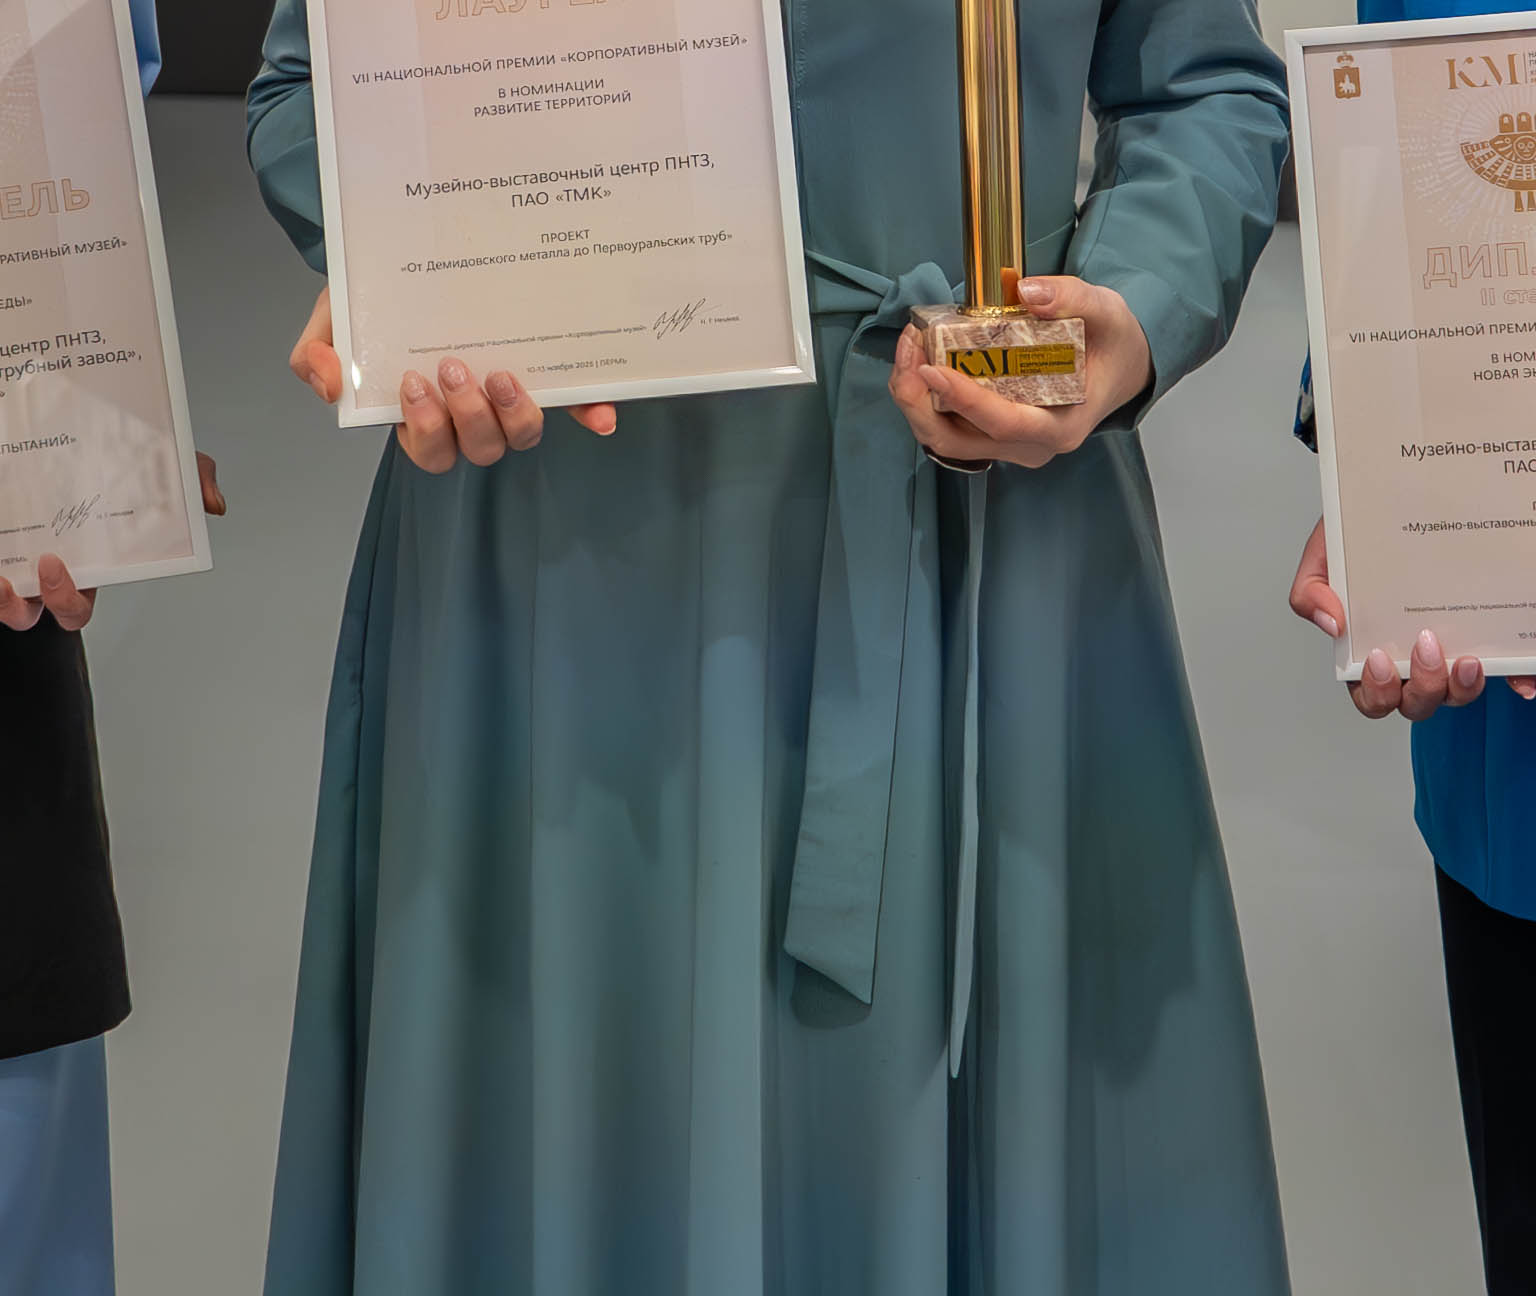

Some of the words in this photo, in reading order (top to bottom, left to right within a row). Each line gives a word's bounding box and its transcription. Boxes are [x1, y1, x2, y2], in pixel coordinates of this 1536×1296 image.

[352, 73, 369, 84] VII
[374, 59, 491, 82] НАЦИОНАЛЬНОЙ
[497, 55, 555, 69] ПРЕМИИ
[499, 88, 506, 98] В
[511, 79, 604, 96] НОМИНАЦИИ
[474, 98, 541, 117] РАЗВИТИЕ
[545, 90, 632, 111] ТЕРРИТОРИЙ
[406, 164, 604, 199] Музейно-выставочный
[610, 162, 659, 177] центр
[665, 154, 714, 170] ПНТЗ,
[512, 192, 548, 207] ПАО
[541, 229, 590, 243] ПРОЕКТ
[426, 255, 516, 272] Демидовского
[520, 247, 570, 261] металла
[574, 246, 589, 257] до
[593, 236, 695, 256] Первоуральских
[1349, 332, 1365, 343] VII
[1370, 323, 1484, 342] НАЦИОНАЛЬНОЙ
[0, 340, 50, 358] центр
[56, 330, 105, 348] ПНТЗ,
[1491, 354, 1499, 363] В
[1474, 366, 1519, 381] НОВАЯ
